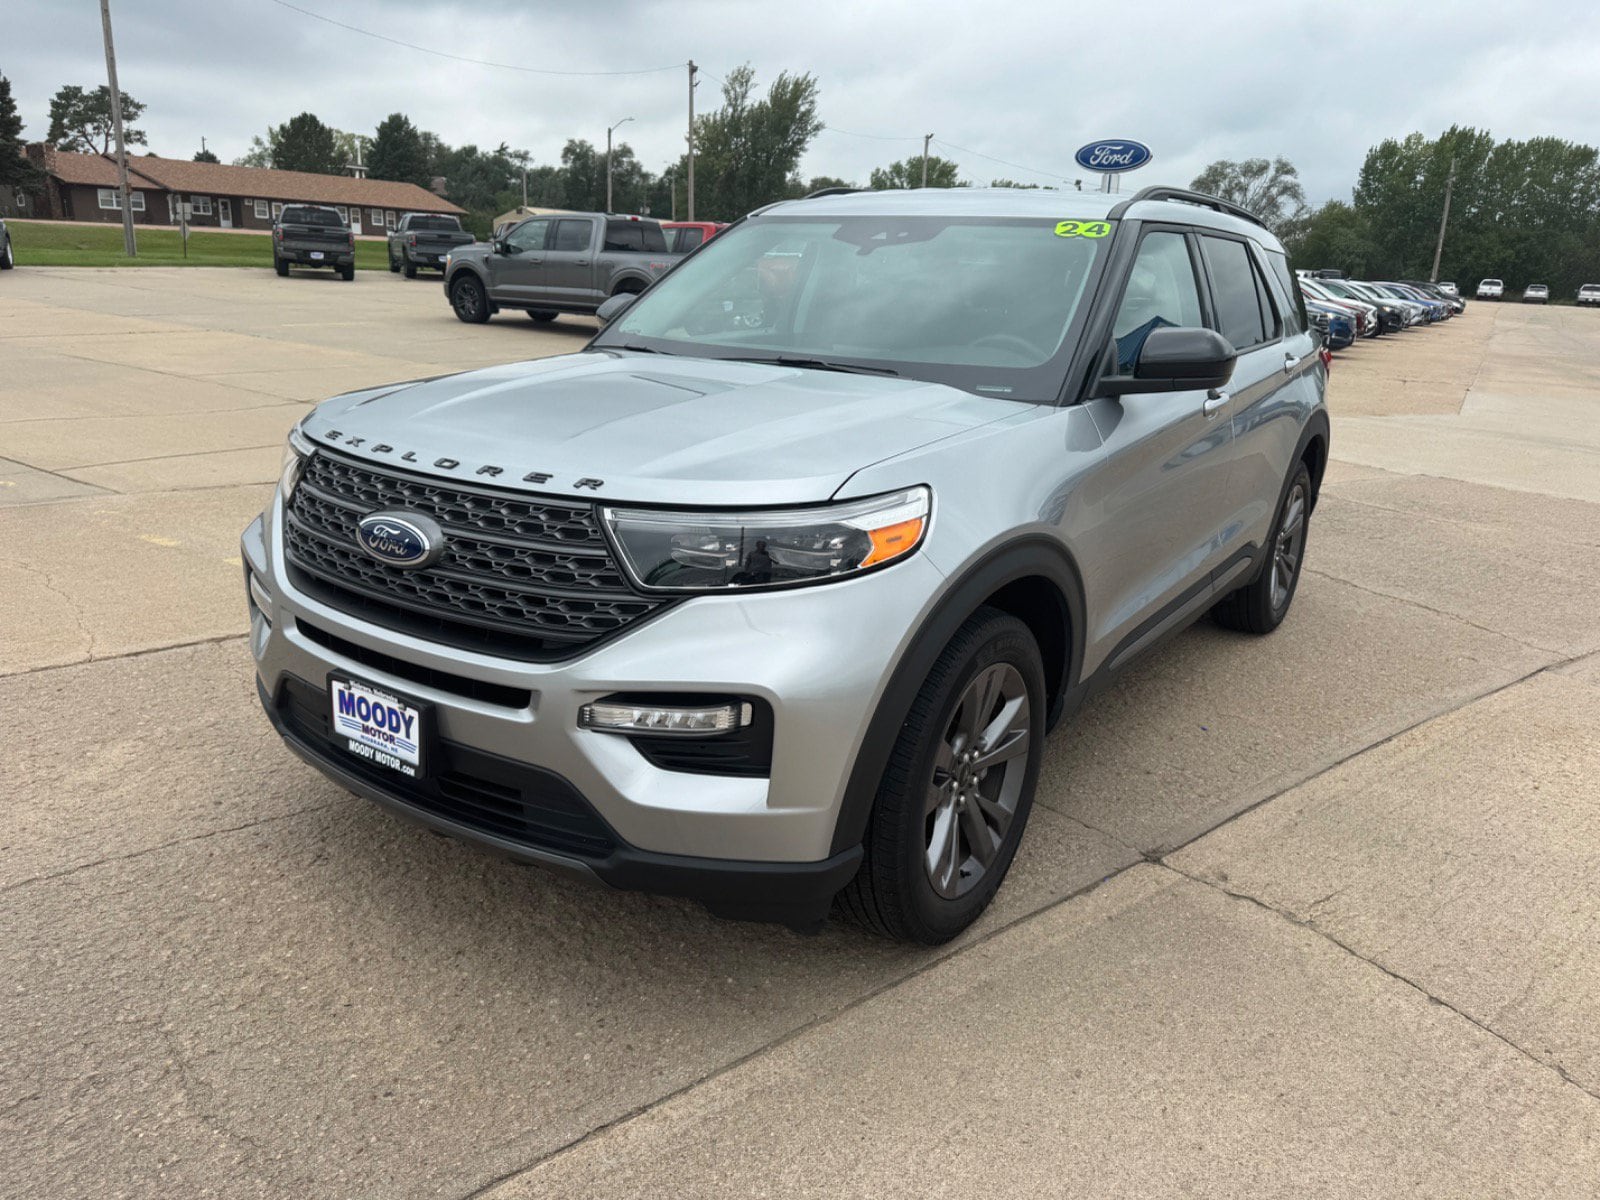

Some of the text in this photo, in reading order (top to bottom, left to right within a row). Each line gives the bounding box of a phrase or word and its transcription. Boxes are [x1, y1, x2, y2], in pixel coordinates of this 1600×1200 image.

[1089, 145, 1134, 165] Ford
[1058, 222, 1108, 236] 24
[325, 430, 604, 490] EXPLORER
[369, 525, 410, 555] Ford
[338, 689, 414, 739] MOODY
[361, 723, 396, 746] MOTOR
[348, 739, 374, 760] MOODY
